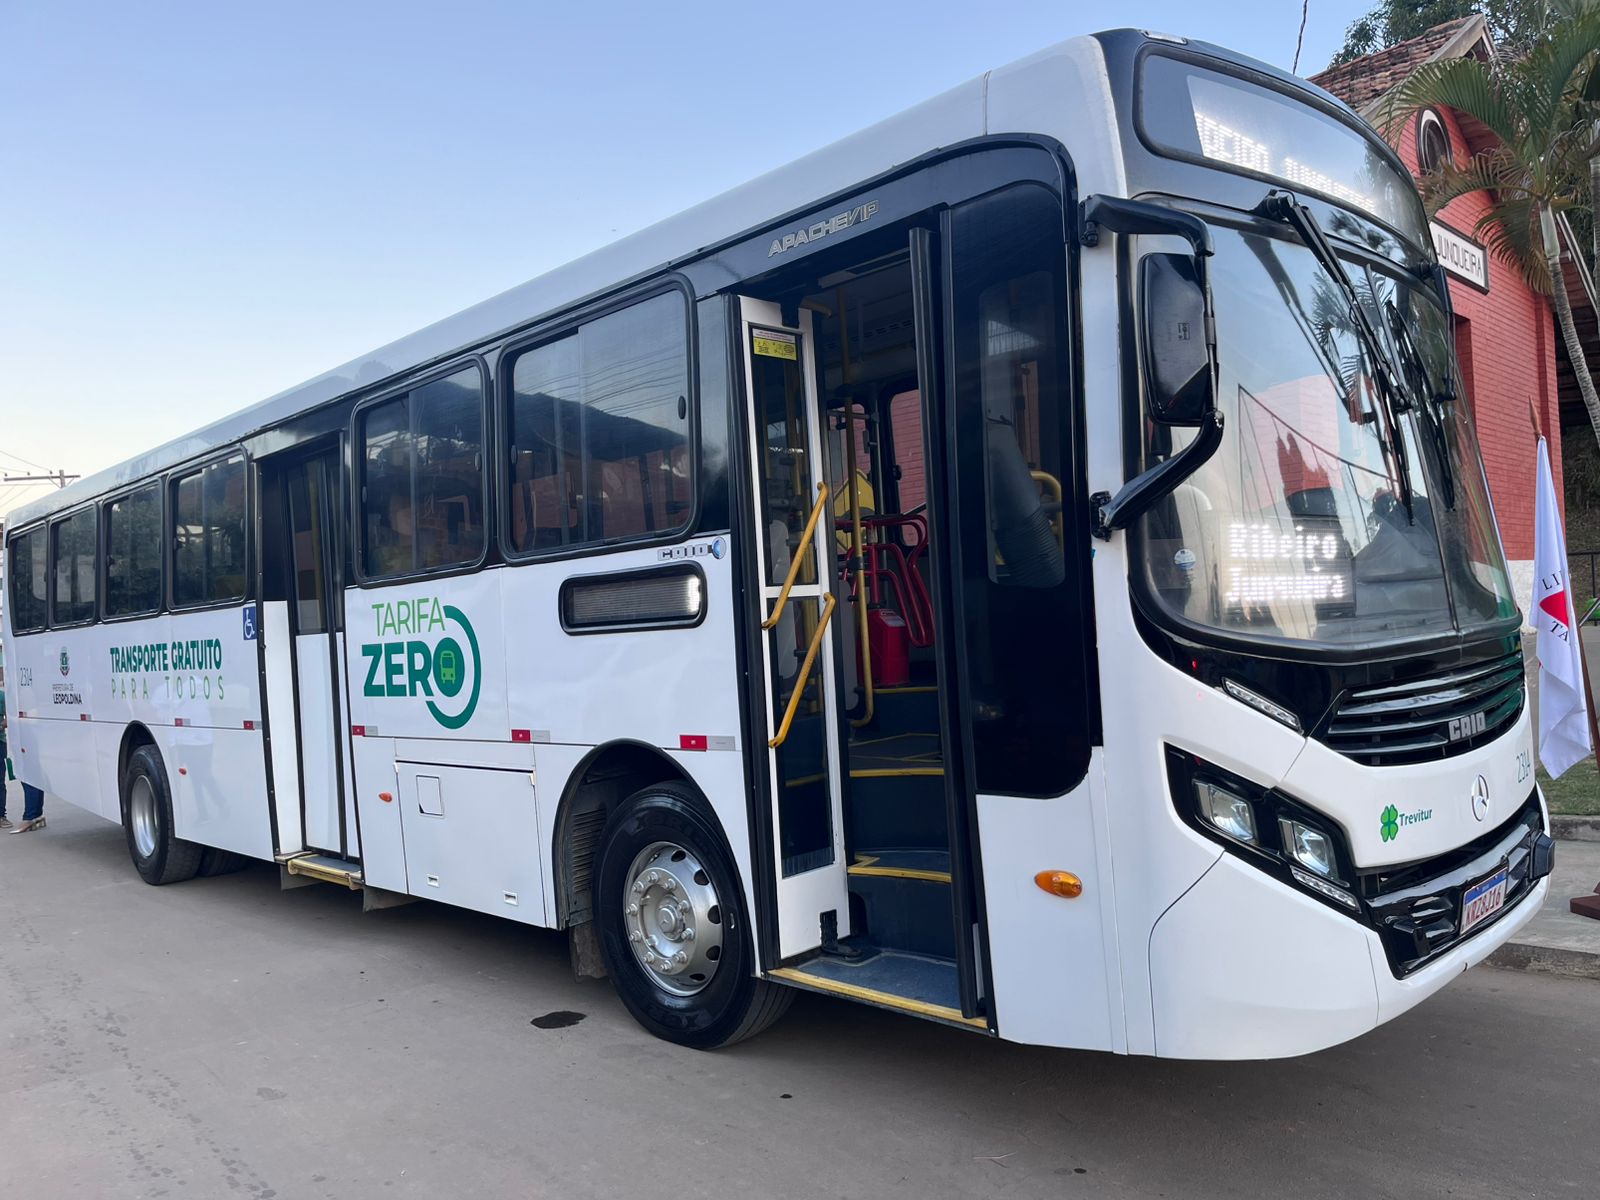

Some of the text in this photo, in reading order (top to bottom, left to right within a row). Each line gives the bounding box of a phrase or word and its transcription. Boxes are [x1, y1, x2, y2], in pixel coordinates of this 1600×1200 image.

[657, 543, 709, 561] CAIO
[1229, 523, 1338, 559] Ribeiro
[371, 596, 446, 637] TARIFA
[109, 638, 222, 674] TRANSPORTE GRATUITO
[362, 636, 466, 698] ZERO
[52, 692, 82, 705] LEOPOLDINA
[112, 674, 225, 701] PARA TODOS
[1448, 711, 1486, 741] CAIO
[1399, 807, 1433, 827] Trevitur
